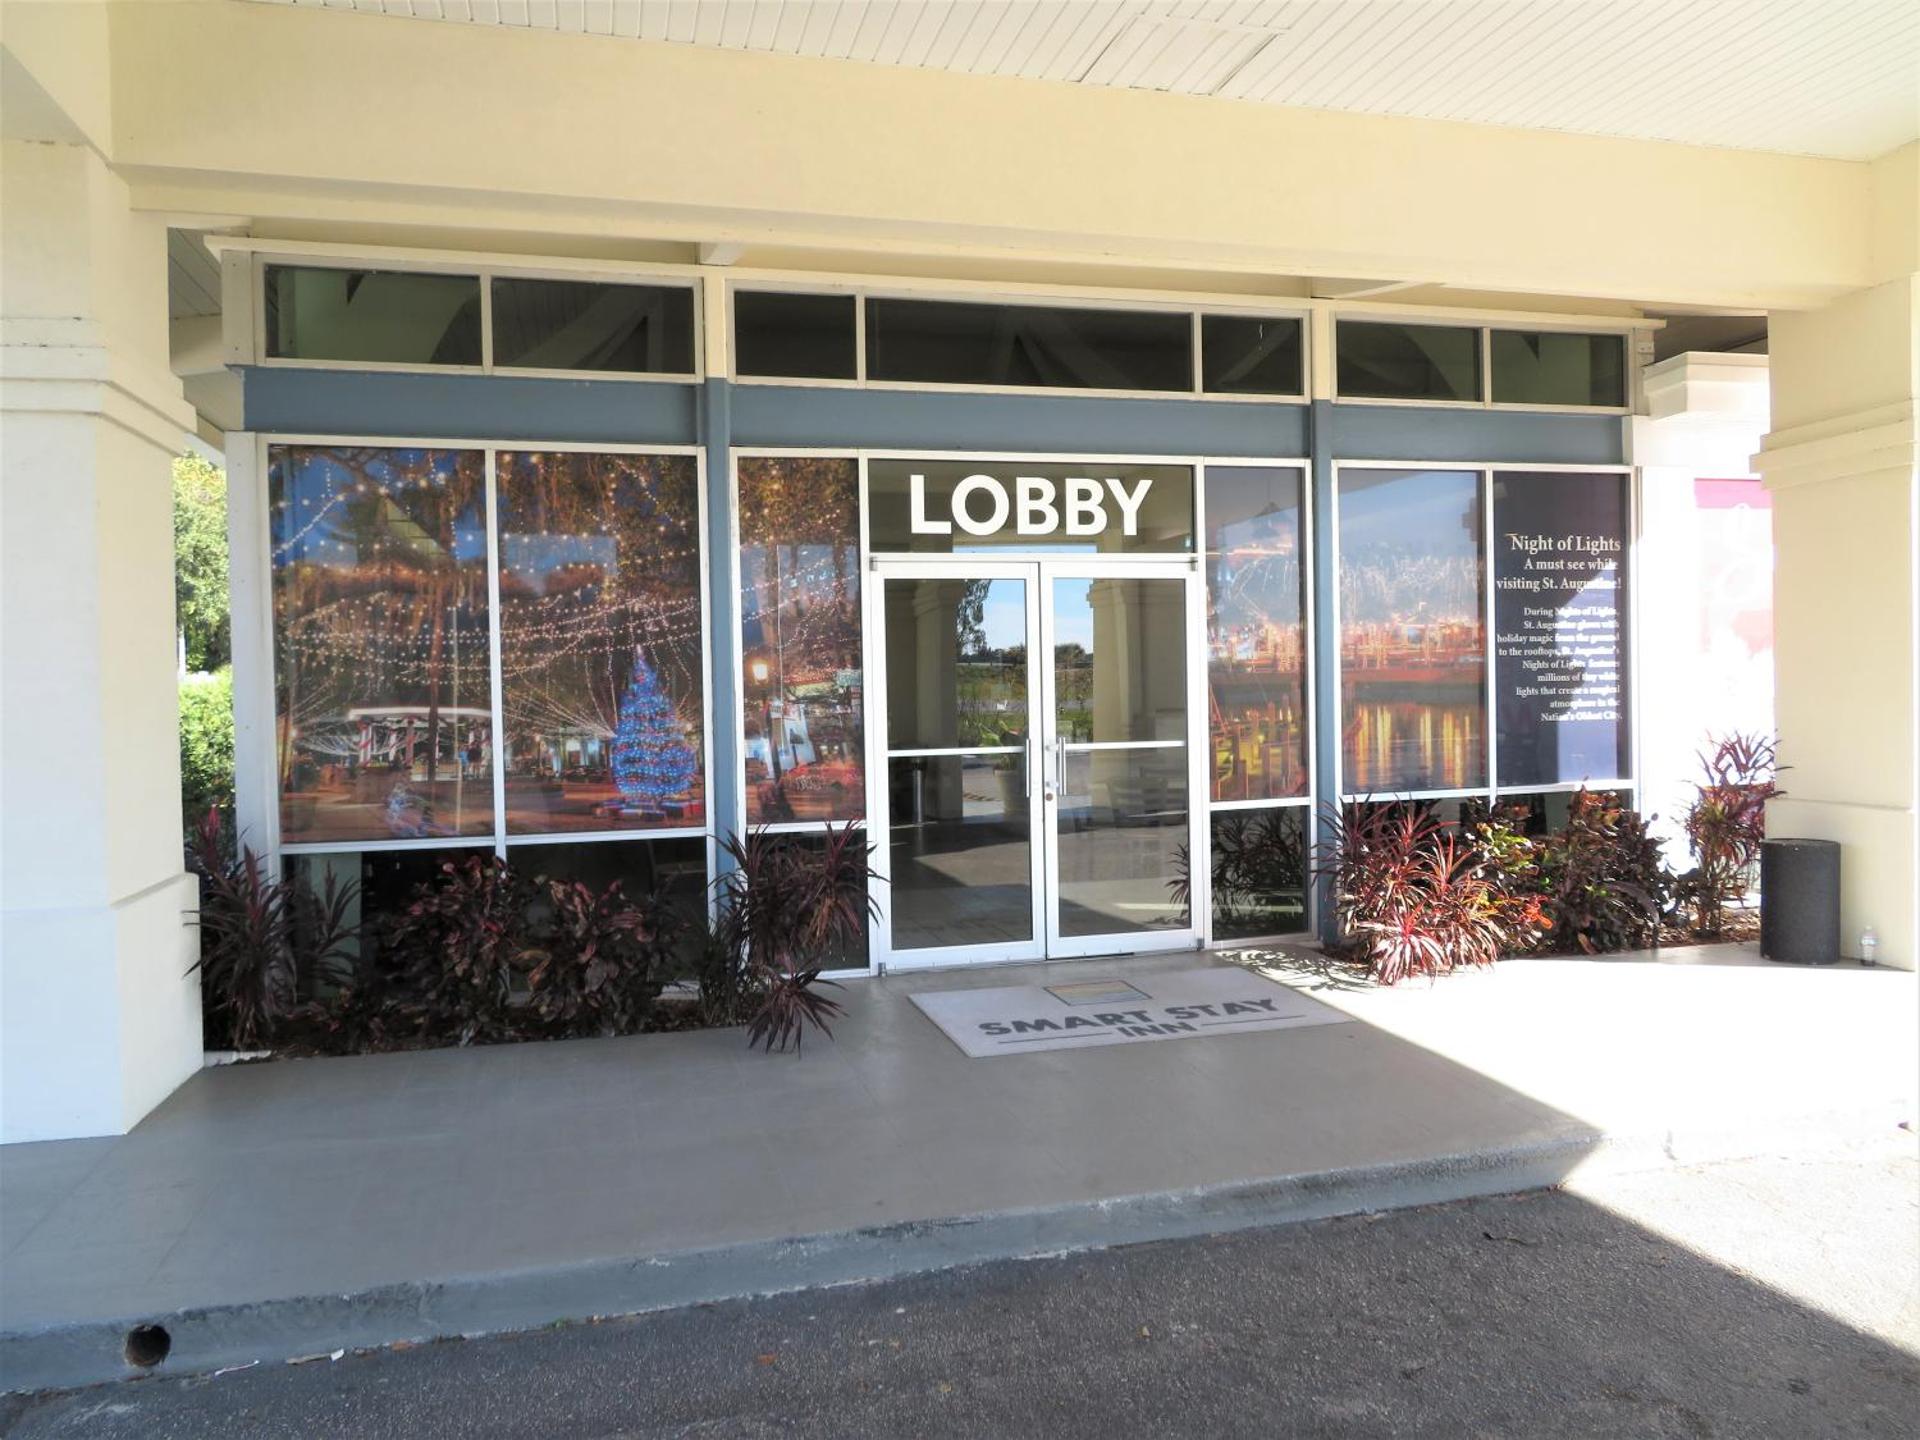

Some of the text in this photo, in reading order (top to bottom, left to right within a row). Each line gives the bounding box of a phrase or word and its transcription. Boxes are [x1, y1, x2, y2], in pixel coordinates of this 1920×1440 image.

[910, 474, 1153, 536] LOBBY
[1511, 535, 1621, 556] Night of Lights
[1523, 558, 1618, 571] A must see while
[1496, 577, 1622, 593] visiting St. Augue!
[1523, 607, 1554, 618] During
[1523, 620, 1535, 630] St.
[1536, 620, 1576, 632] Augue
[1601, 620, 1619, 629] wh
[1497, 633, 1528, 645] holiday
[1529, 634, 1554, 645] magic
[1498, 647, 1507, 656] to
[1509, 647, 1522, 656] the
[1522, 660, 1549, 671] Nights
[1550, 660, 1560, 669] of
[1537, 672, 1570, 682] millions
[1571, 672, 1581, 681] of
[1597, 671, 1620, 681] whe
[1515, 686, 1538, 698] lights
[1540, 685, 1556, 695] that
[1549, 698, 1596, 710] atmoph
[1540, 711, 1575, 722] Nati's
[1576, 711, 1602, 721] Oldt
[978, 997, 1281, 1037] SMART STAY
[1115, 1021, 1198, 1038] INN
